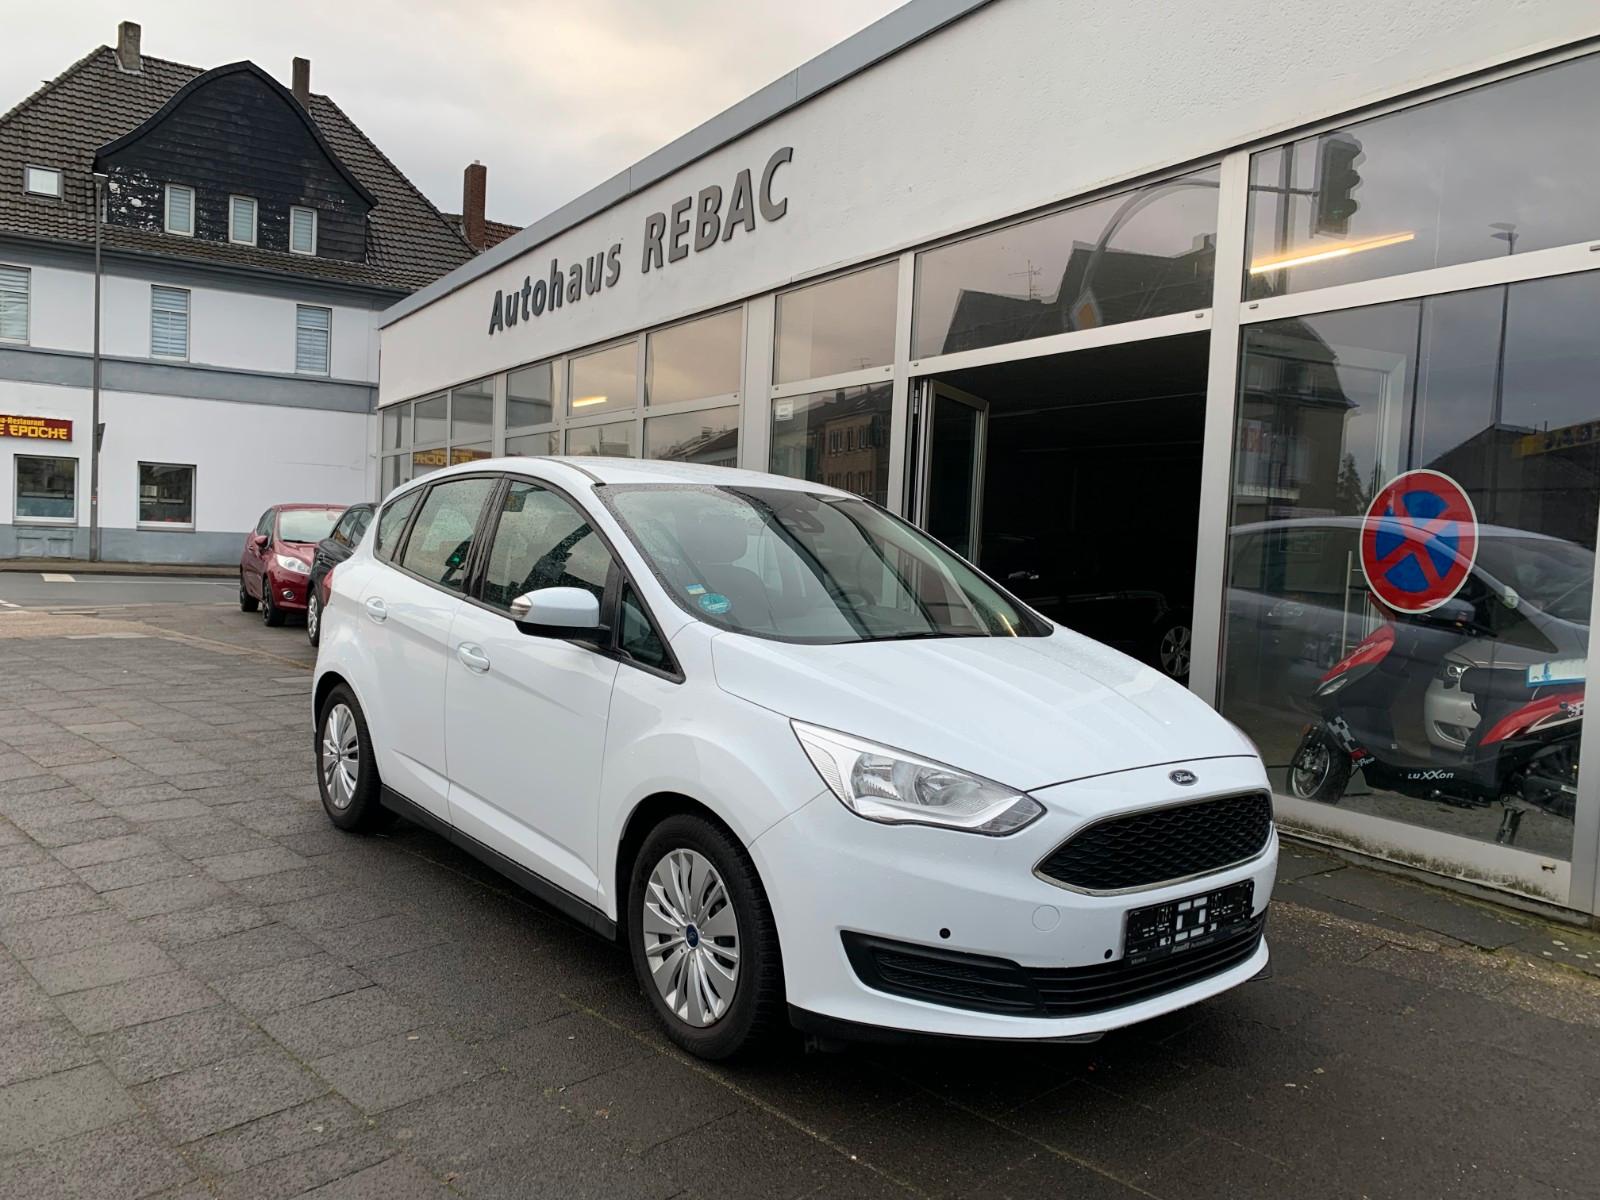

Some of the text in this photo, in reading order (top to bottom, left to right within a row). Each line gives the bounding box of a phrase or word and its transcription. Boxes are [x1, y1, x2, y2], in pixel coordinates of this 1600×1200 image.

[488, 146, 794, 335] Autohaus REBAC
[9, 424, 68, 440] EPOCHE
